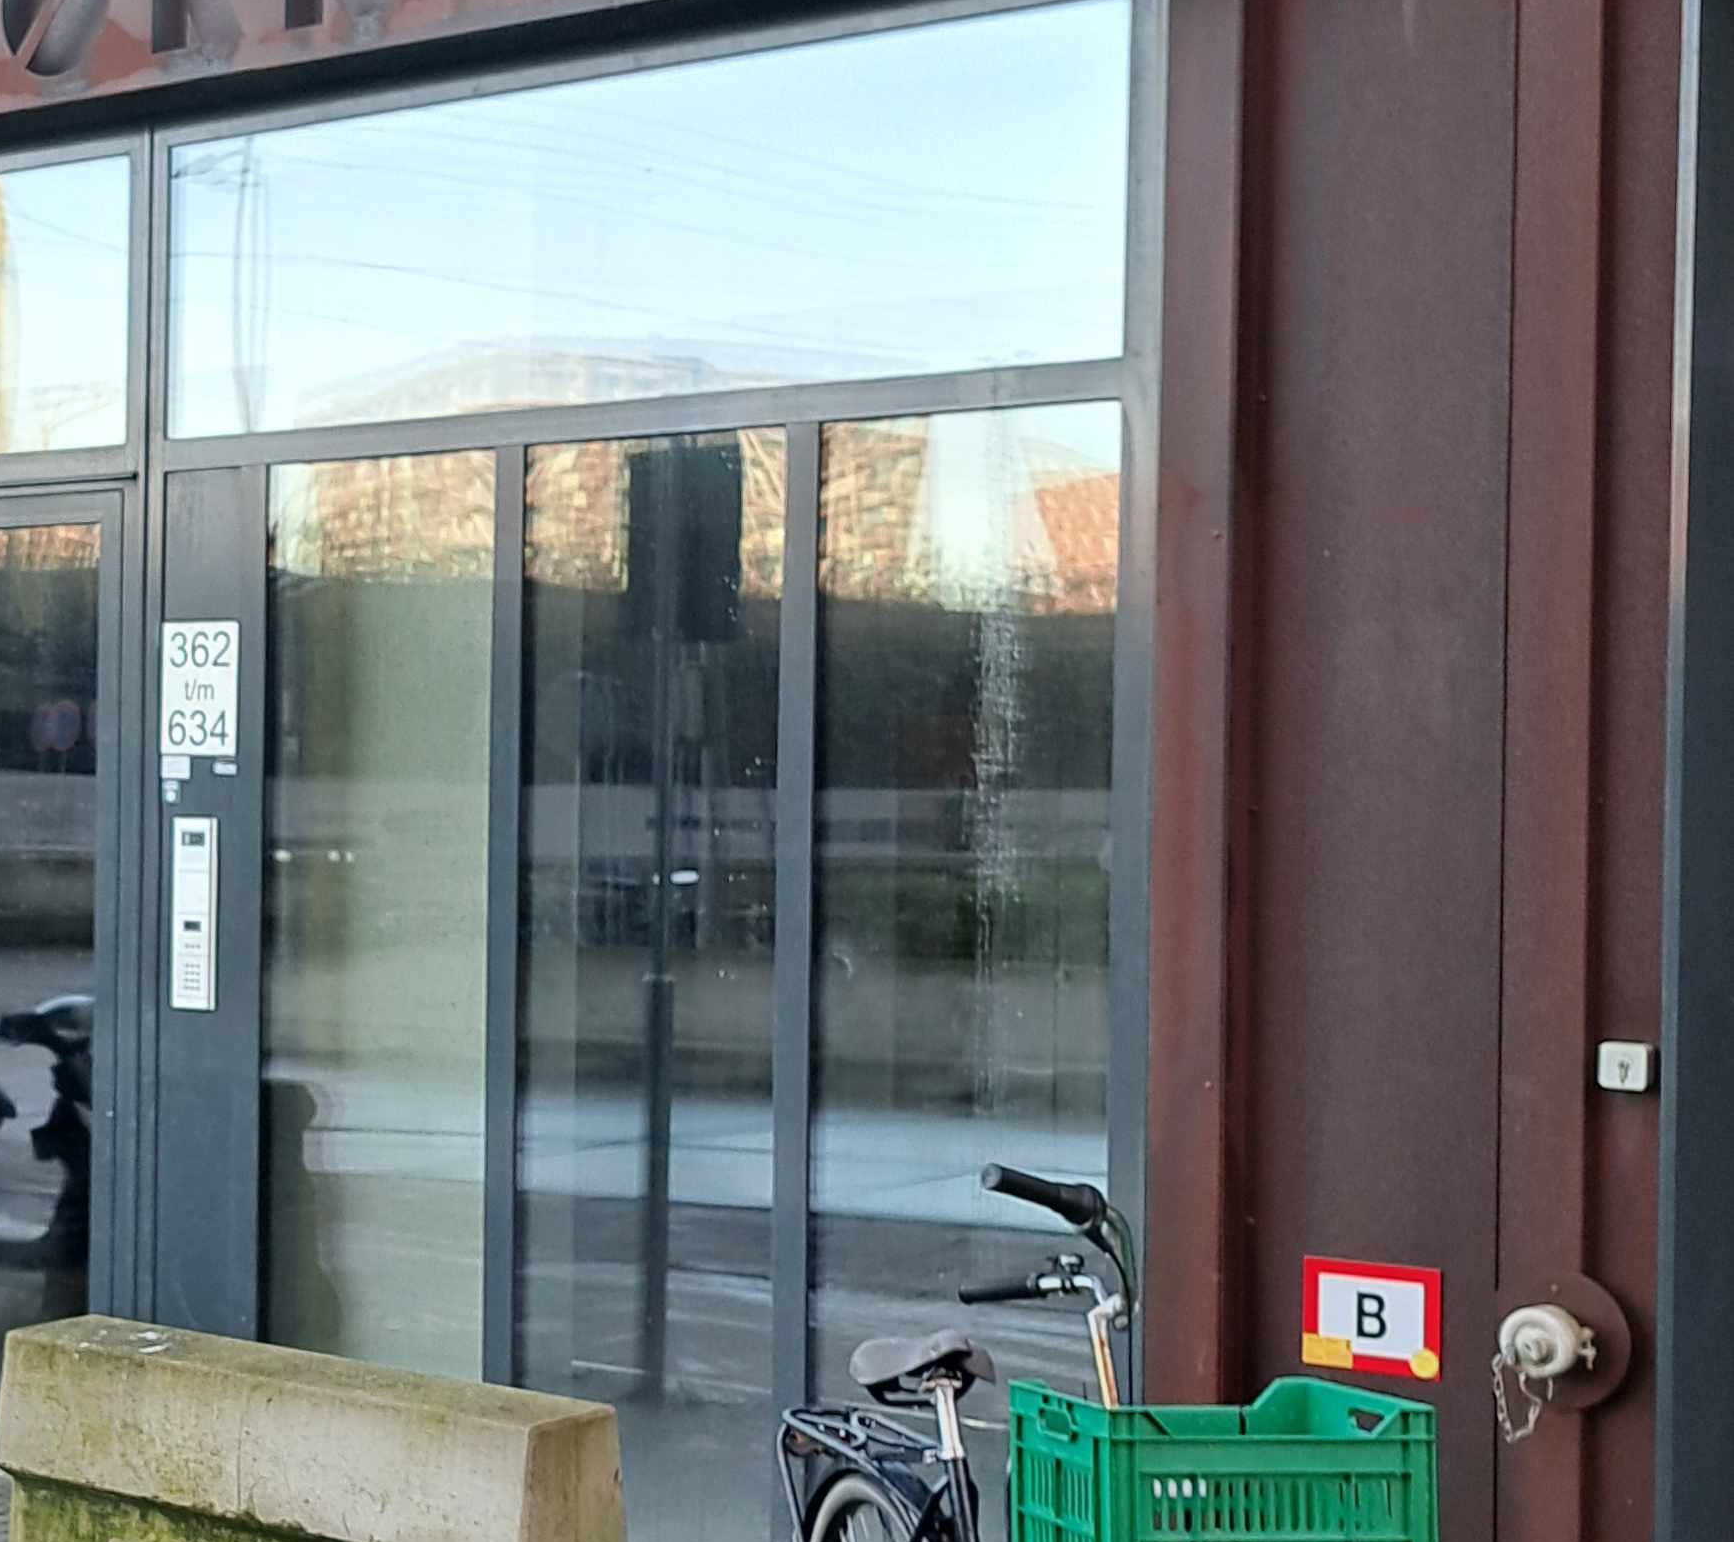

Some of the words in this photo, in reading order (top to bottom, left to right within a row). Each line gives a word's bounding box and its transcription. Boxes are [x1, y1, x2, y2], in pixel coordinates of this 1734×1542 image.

[169, 630, 231, 668] 362
[184, 678, 215, 701] t/m
[168, 709, 229, 747] 634
[1356, 1290, 1387, 1339] B
